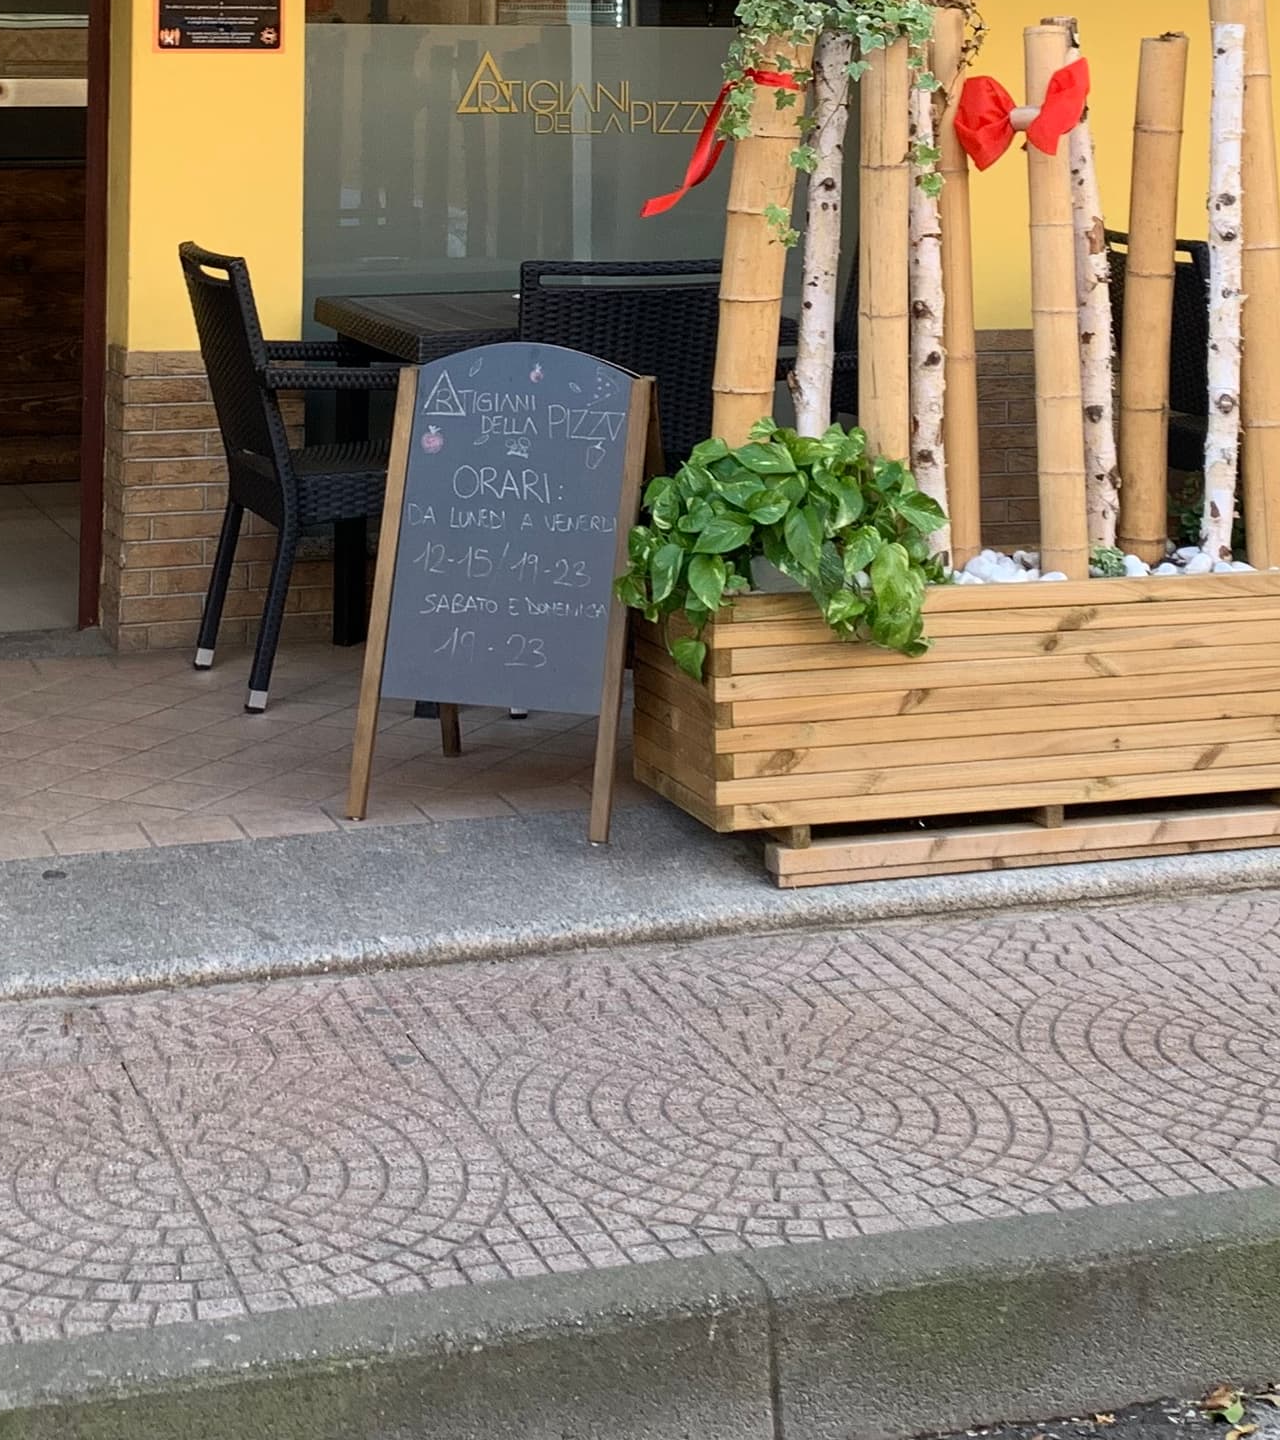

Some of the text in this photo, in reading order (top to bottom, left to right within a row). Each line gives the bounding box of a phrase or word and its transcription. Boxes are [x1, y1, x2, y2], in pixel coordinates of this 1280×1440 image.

[456, 50, 629, 114] ARTIGIANI
[534, 111, 624, 134] DELLA
[423, 369, 536, 417] ARTIGIANI
[481, 414, 538, 436] DELLA
[407, 503, 436, 527] DA
[520, 513, 533, 532] A
[420, 593, 498, 614] SABATO
[508, 598, 519, 616] E
